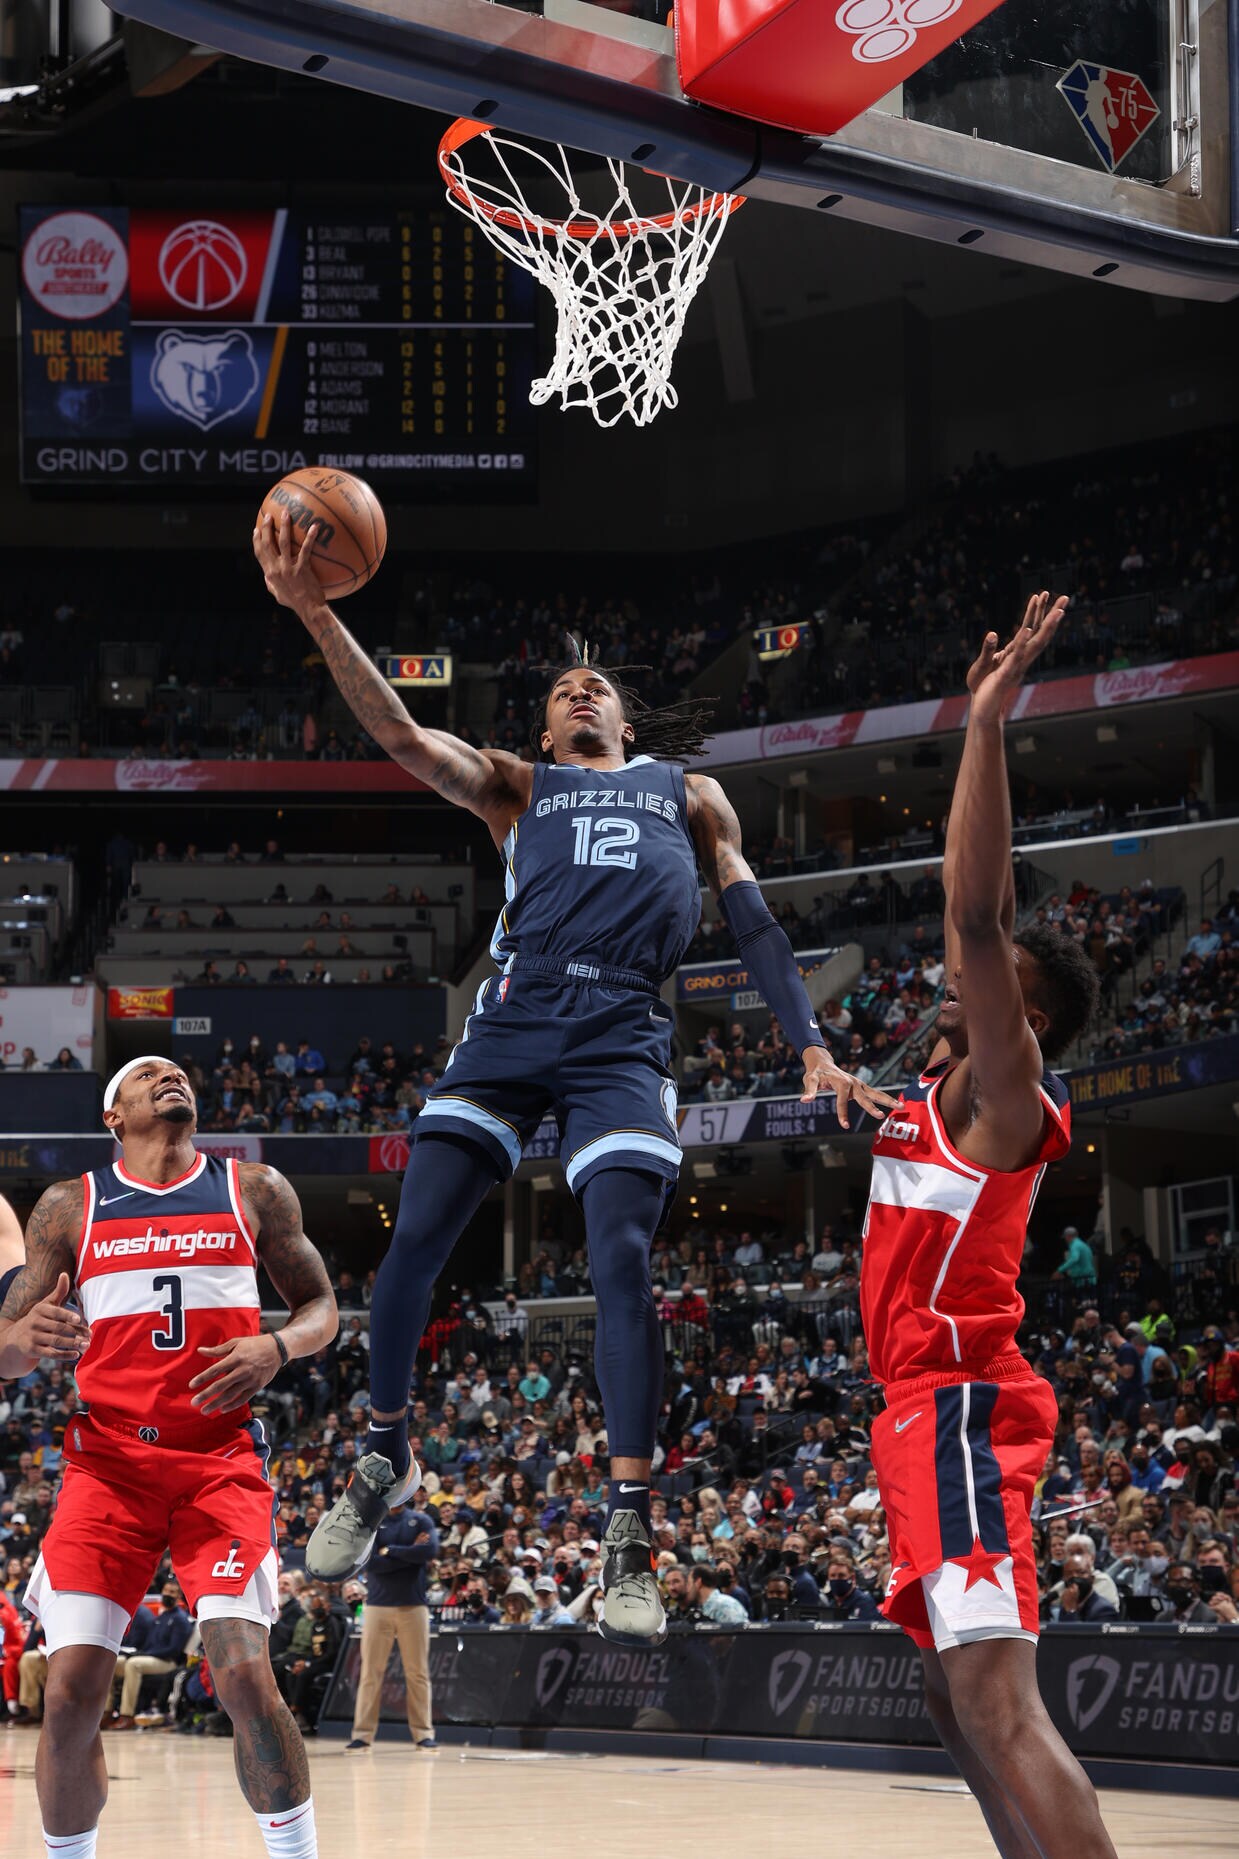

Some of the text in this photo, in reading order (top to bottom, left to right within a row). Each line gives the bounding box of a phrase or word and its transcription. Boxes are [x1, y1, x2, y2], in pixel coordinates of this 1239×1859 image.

[1118, 87, 1138, 119] 75
[35, 236, 115, 273] Bally
[305, 246, 315, 262] 3
[32, 330, 124, 356] THE HOME
[47, 357, 110, 381] OF THE
[304, 419, 319, 434] 22
[36, 449, 306, 473] GRIND CITY MEDIA
[318, 454, 364, 467] FOLLOW
[536, 790, 678, 822] GRIZZLIES
[571, 816, 640, 870] 12
[684, 971, 748, 991] GRIND CIT
[180, 1020, 207, 1032] 107A
[1070, 1074, 1095, 1103] THE
[1097, 1065, 1135, 1098] HOME
[701, 1108, 729, 1142] 57
[765, 1117, 815, 1136] FOULS: 4
[93, 1226, 236, 1259] washington
[151, 1274, 185, 1350] 3
[212, 1539, 245, 1578] dc
[571, 1652, 671, 1683] FANDUEL
[813, 1655, 925, 1691] FANDUE
[564, 1687, 666, 1707] SPORTSBOOK
[1118, 1706, 1239, 1734] SPORTSB
